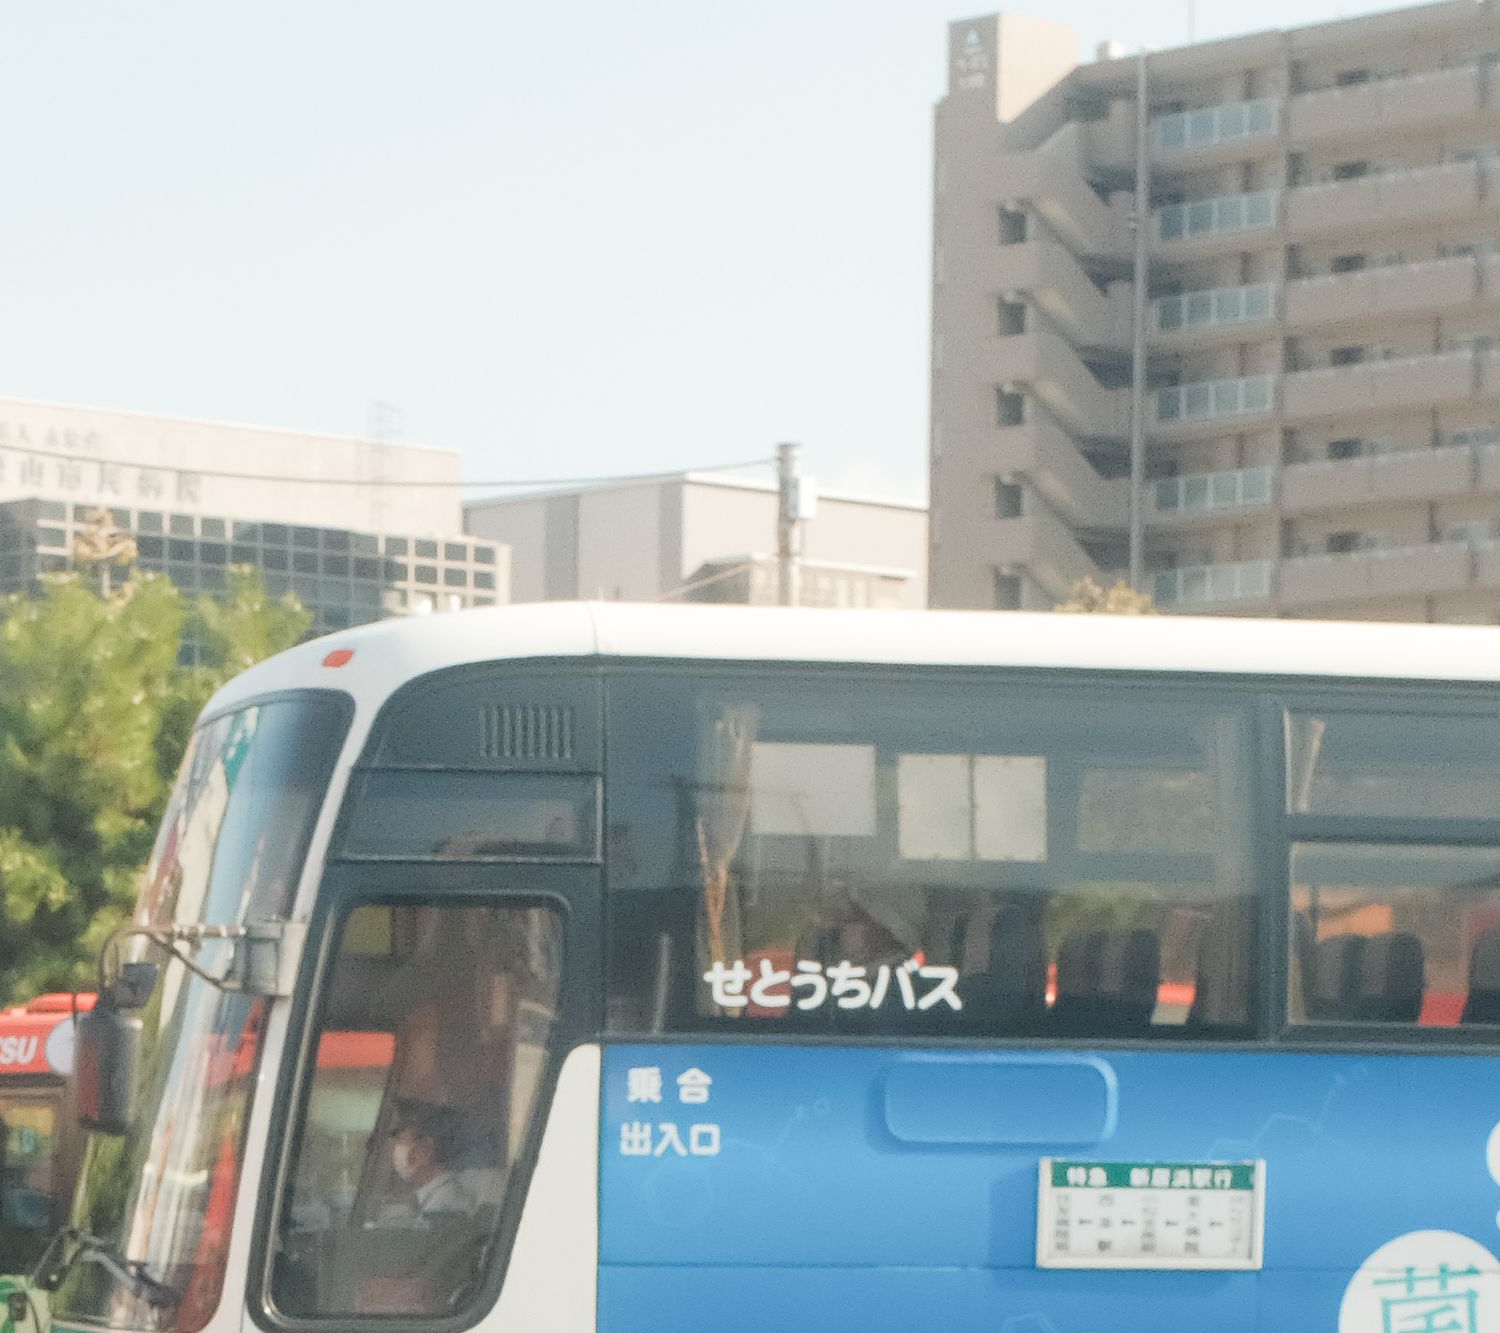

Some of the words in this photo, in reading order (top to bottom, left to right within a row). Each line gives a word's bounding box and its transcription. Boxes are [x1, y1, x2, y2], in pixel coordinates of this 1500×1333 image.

[703, 958, 962, 1010] せとうちバス
[619, 1121, 721, 1157] 出入口
